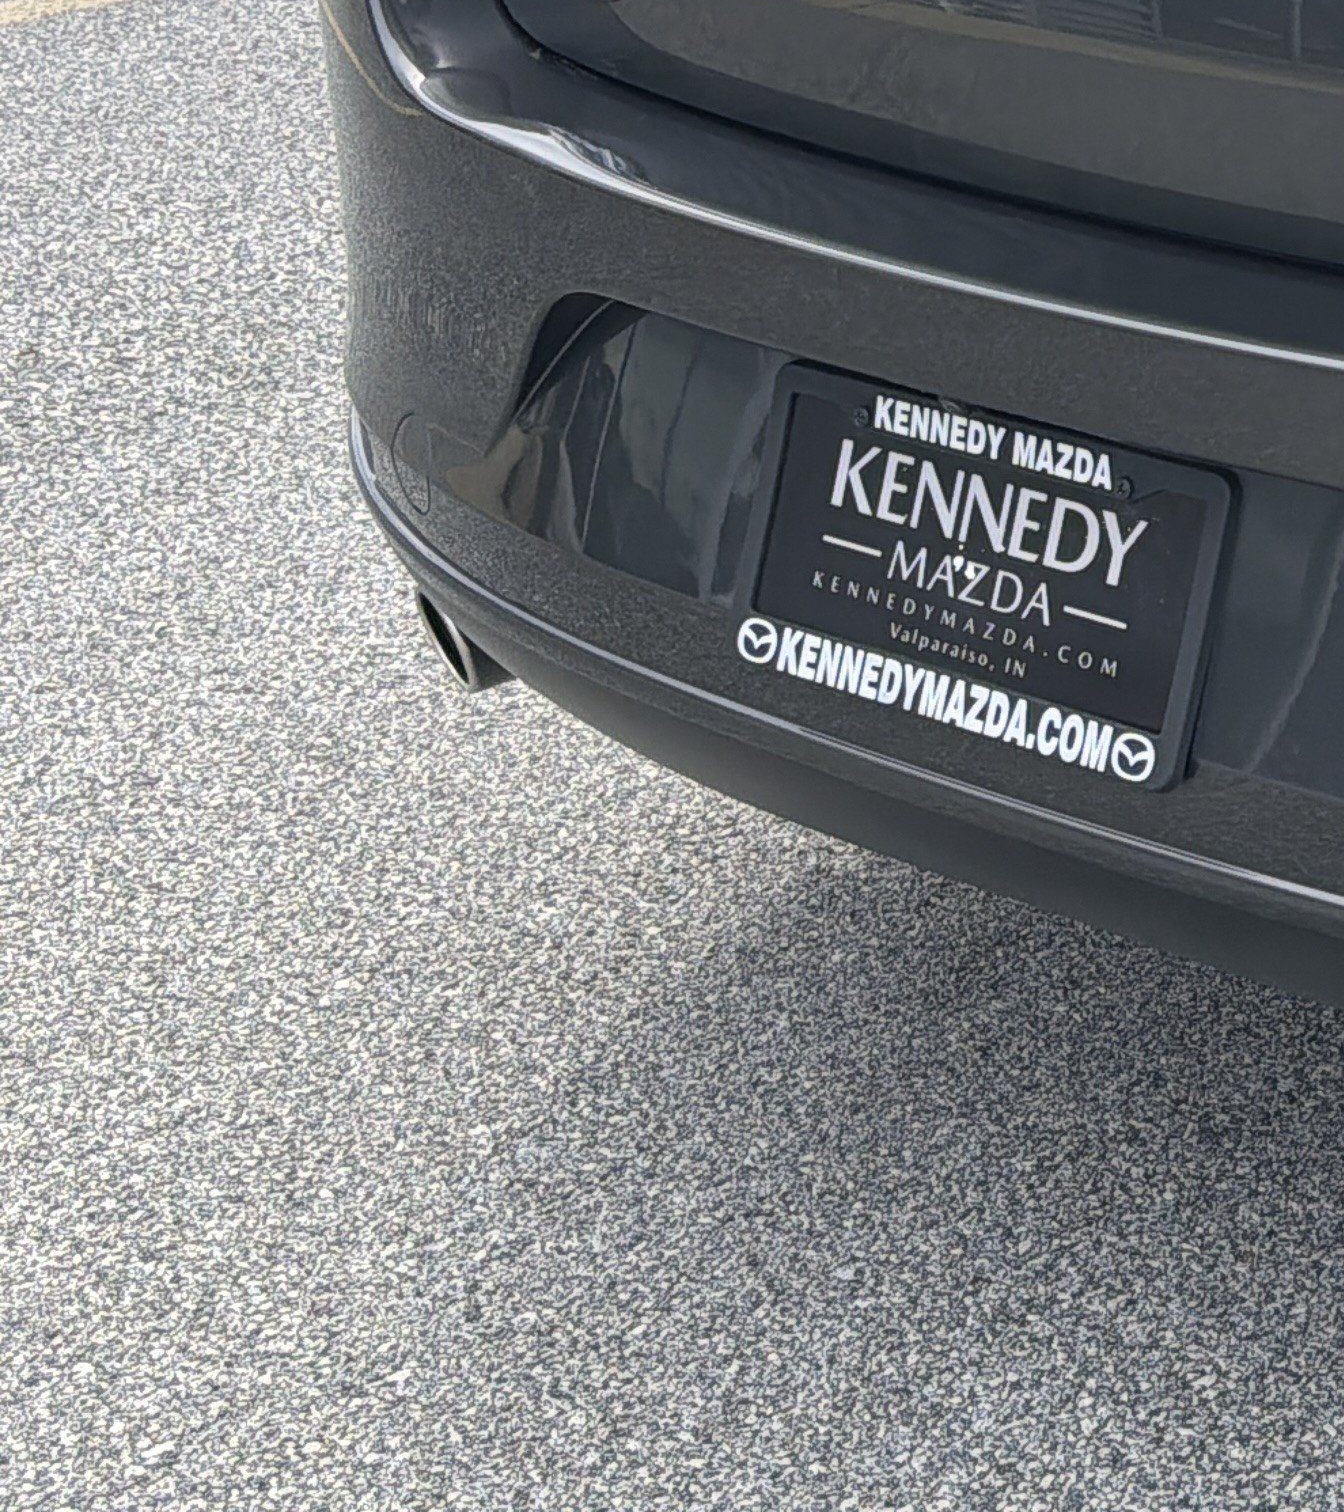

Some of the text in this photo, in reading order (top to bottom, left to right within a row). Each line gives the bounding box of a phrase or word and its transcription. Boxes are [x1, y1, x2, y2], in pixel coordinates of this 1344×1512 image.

[873, 394, 1113, 491] KENNEDY MAZDA
[829, 438, 1149, 588] KENNEDY
[811, 568, 1119, 678] KENNEDYMAZDA.COM
[886, 539, 1053, 627] MAZDA
[776, 626, 1113, 773] KENNEDYMAZDA.COM
[889, 621, 1027, 678] Valparaiso, IN
